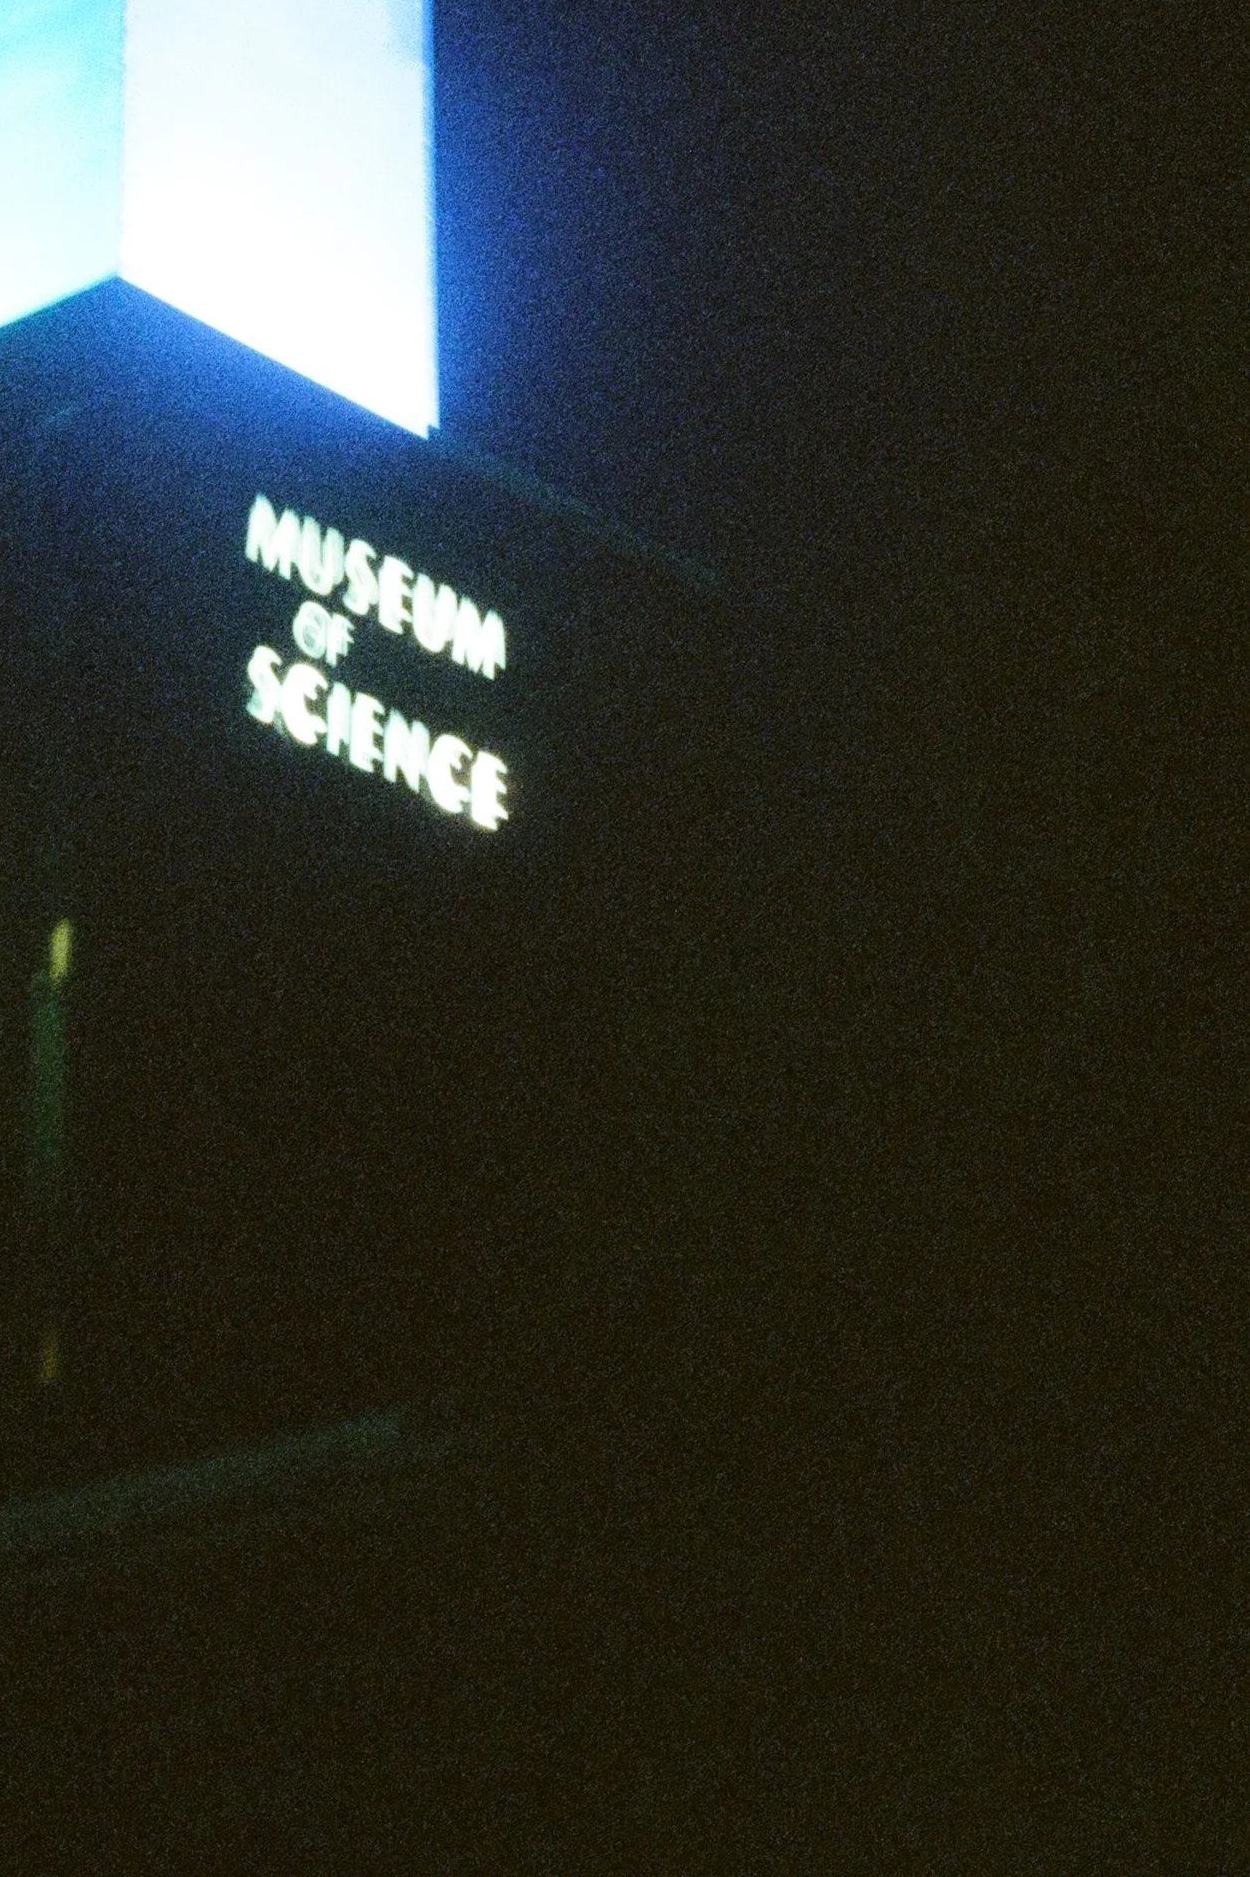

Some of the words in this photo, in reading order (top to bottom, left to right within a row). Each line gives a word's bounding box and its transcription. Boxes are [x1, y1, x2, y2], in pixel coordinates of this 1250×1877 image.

[245, 492, 506, 680] MUSEUM
[291, 600, 354, 667] OF
[246, 645, 509, 831] SCIENCE
